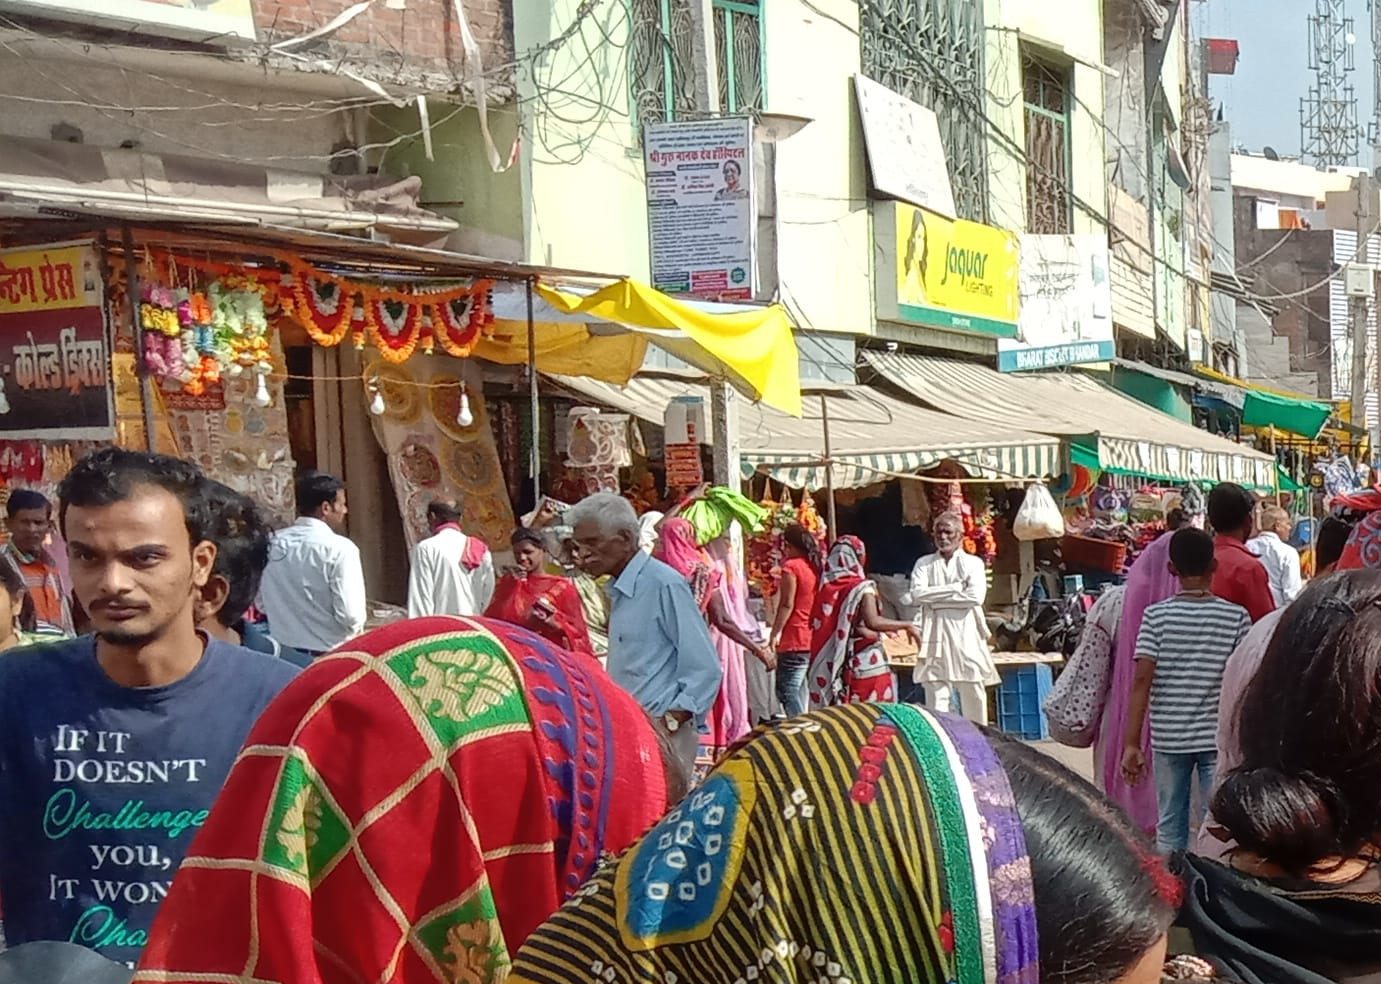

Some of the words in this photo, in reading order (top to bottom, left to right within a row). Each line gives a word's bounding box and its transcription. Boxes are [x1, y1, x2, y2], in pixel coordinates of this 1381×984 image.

[39, 253, 76, 305] प्रेस
[12, 330, 62, 391] कोल्ड
[54, 724, 89, 751] IF
[95, 730, 131, 754] IT
[53, 758, 207, 784] DOESN'T
[43, 788, 209, 839] Challenge
[88, 844, 172, 871] you,
[50, 874, 80, 901] IT
